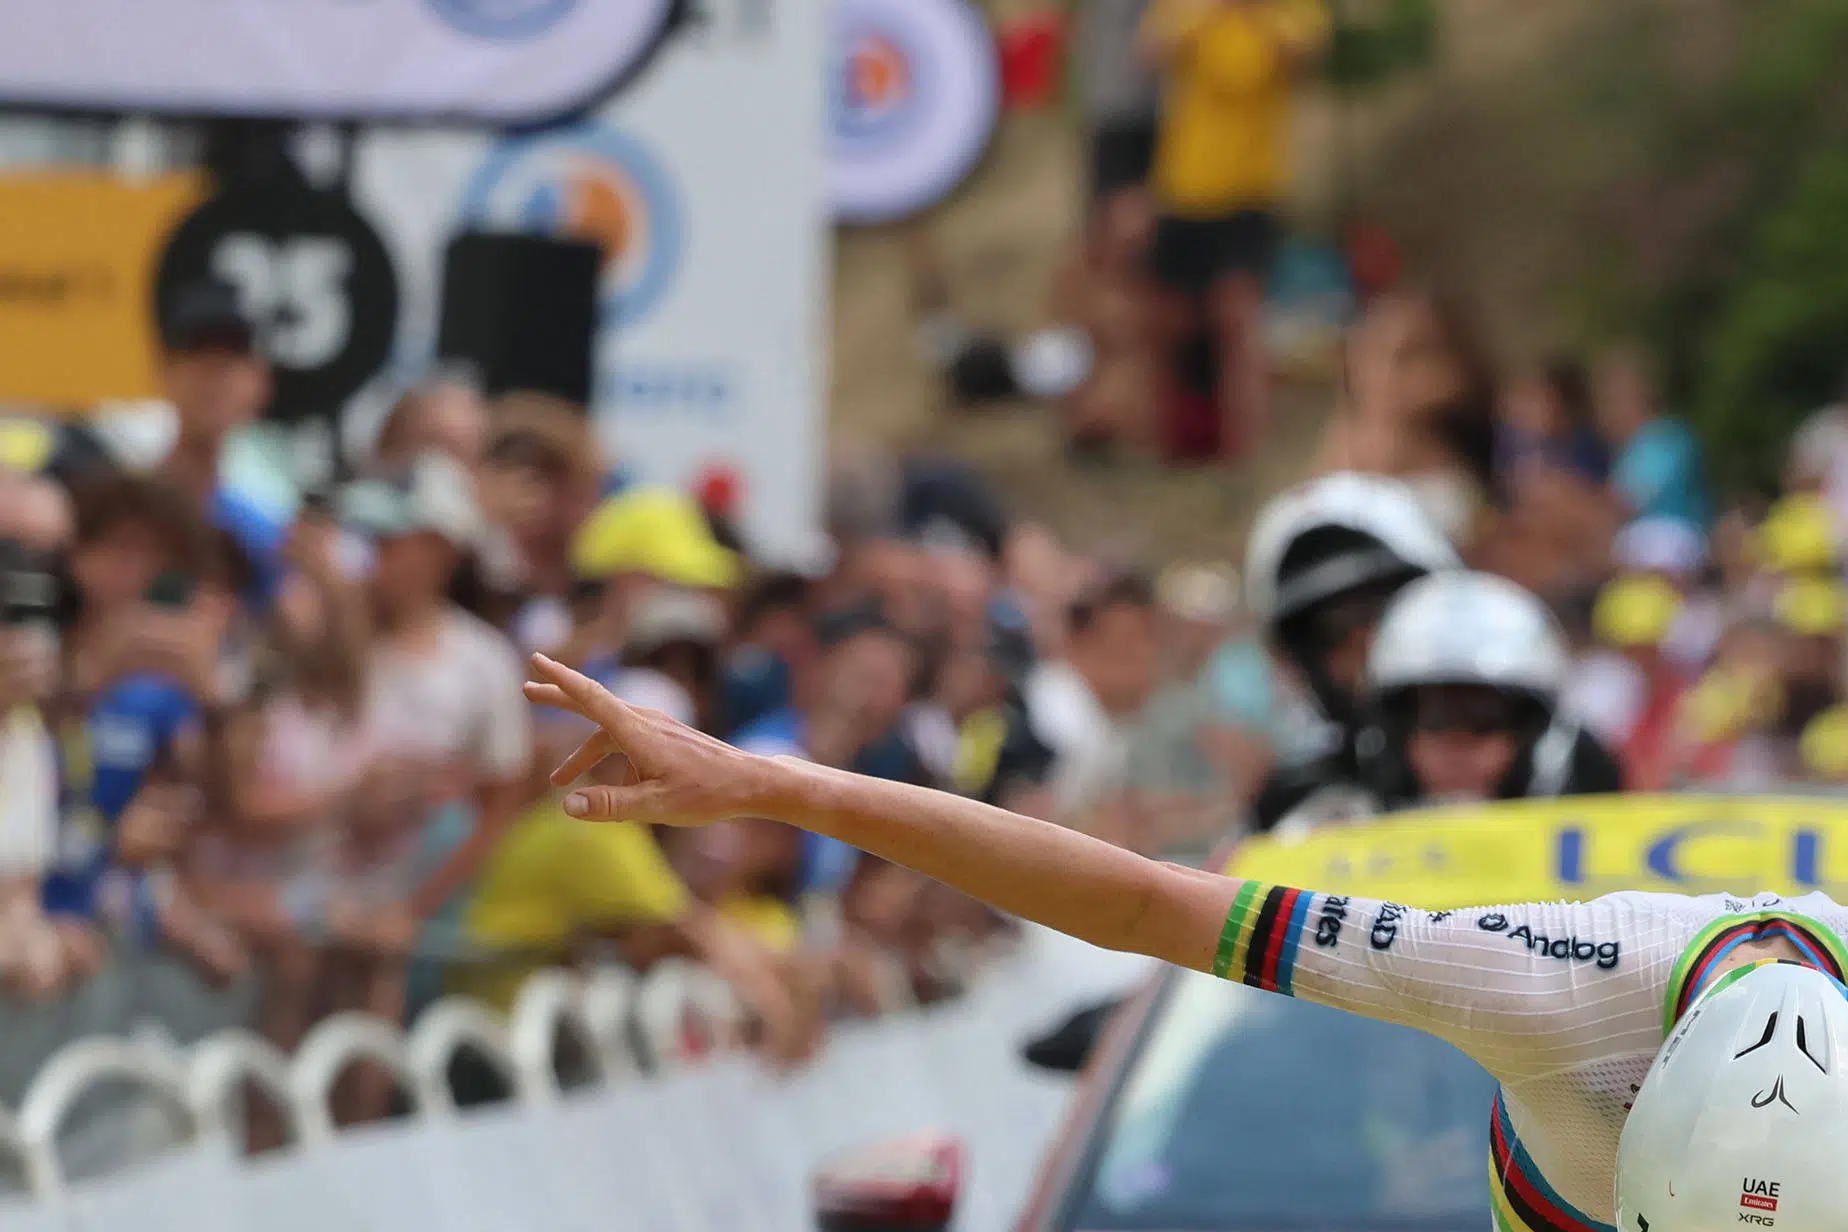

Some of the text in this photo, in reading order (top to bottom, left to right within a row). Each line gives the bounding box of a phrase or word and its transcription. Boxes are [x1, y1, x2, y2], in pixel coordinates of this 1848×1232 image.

[1506, 925, 1620, 969] Analog
[1742, 1177, 1781, 1198] UAE
[1743, 1196, 1775, 1209] Emirates
[1738, 1212, 1775, 1228] XRG
